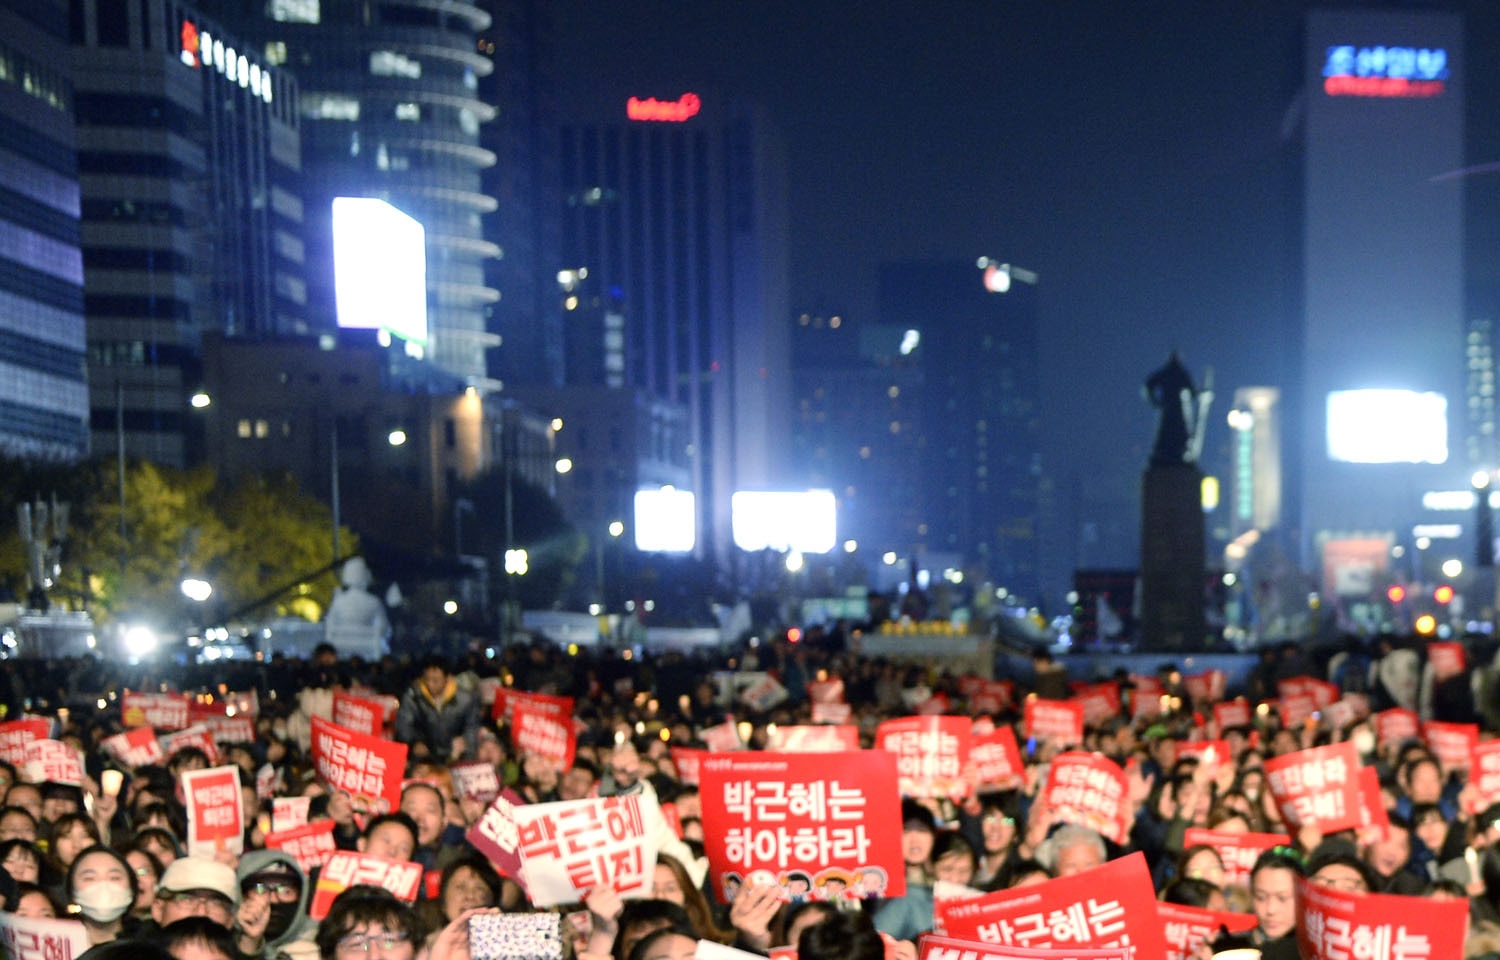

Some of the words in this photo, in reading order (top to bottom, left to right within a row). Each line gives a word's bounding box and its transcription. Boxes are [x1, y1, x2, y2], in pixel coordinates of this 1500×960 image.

[318, 731, 387, 775] 박근혜는
[723, 780, 867, 823] 박근혜는
[517, 796, 645, 860] 박근혜
[723, 824, 871, 869] 하야하라
[566, 845, 645, 902] 퇴진
